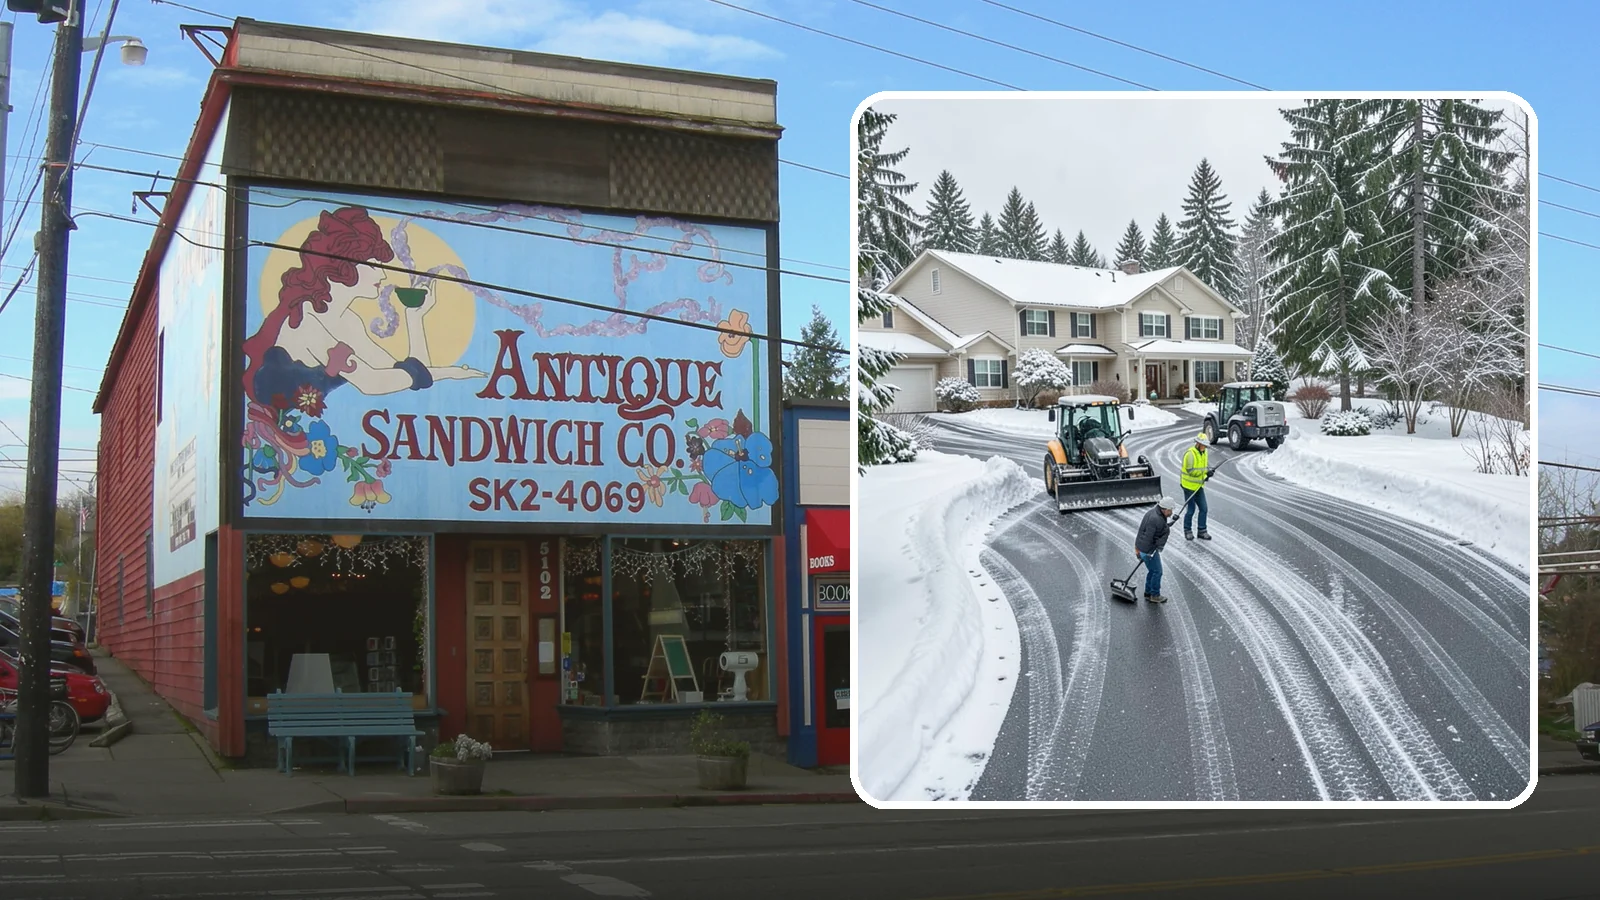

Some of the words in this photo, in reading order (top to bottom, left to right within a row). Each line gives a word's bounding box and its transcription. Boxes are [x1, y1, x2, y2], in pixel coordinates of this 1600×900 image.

[476, 329, 723, 421] ANTIQUE
[361, 408, 604, 467] SANDWICH
[617, 421, 685, 470] CO.
[468, 477, 645, 513] SK2-4069
[540, 541, 552, 599] 5102
[809, 555, 835, 569] BOOKS
